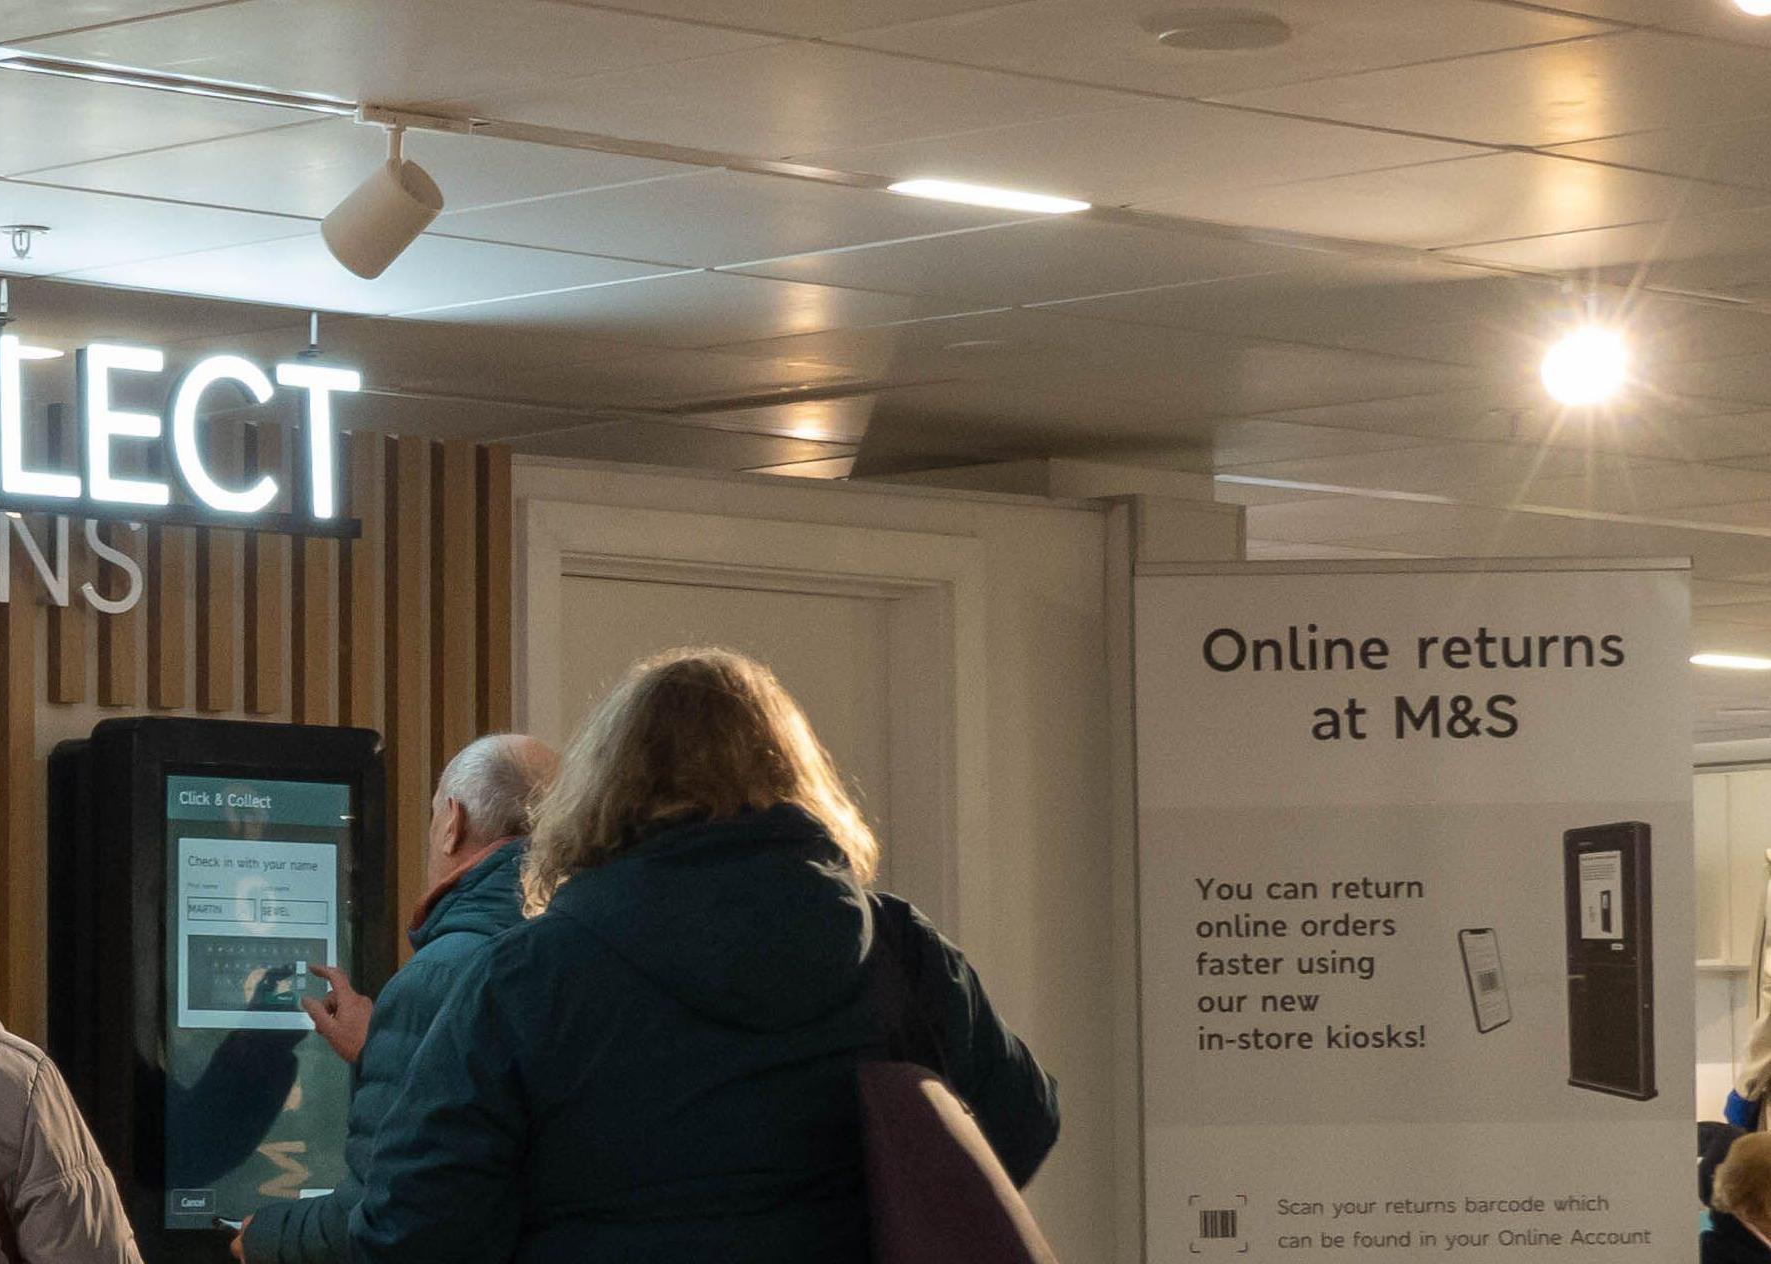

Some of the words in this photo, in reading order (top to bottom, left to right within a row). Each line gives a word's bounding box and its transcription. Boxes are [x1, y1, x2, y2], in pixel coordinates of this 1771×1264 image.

[1203, 623, 1389, 672] Online
[1418, 627, 1625, 669] returns
[1312, 698, 1367, 741] at
[1395, 694, 1518, 739] M&S
[178, 791, 211, 805] Click
[214, 793, 223, 806] &
[227, 793, 272, 809] Collect
[188, 855, 220, 868] Check
[224, 856, 233, 868] in
[237, 857, 260, 869] with
[263, 861, 286, 872] your
[290, 861, 318, 872] name
[1195, 878, 1253, 901] You
[1266, 882, 1318, 900] can
[1332, 877, 1424, 900] return
[1196, 913, 1288, 939] online
[1300, 913, 1397, 937] orders
[1196, 951, 1284, 976] faster
[1297, 949, 1375, 980] using
[1197, 994, 1248, 1013] our
[1261, 994, 1320, 1013] new
[1198, 1025, 1313, 1051] in-store
[1326, 1024, 1425, 1049] kiosks!
[1277, 1198, 1324, 1216] Scan
[1332, 1201, 1377, 1219] your
[1385, 1199, 1457, 1214] returns
[1464, 1197, 1545, 1214] barcode
[1553, 1195, 1610, 1212] which
[1277, 1235, 1313, 1249] can
[1320, 1232, 1345, 1249] be
[1353, 1230, 1412, 1248] found
[1419, 1234, 1437, 1247] in
[1445, 1233, 1490, 1252] your
[1498, 1229, 1563, 1247] Online
[1570, 1229, 1652, 1246] Account
